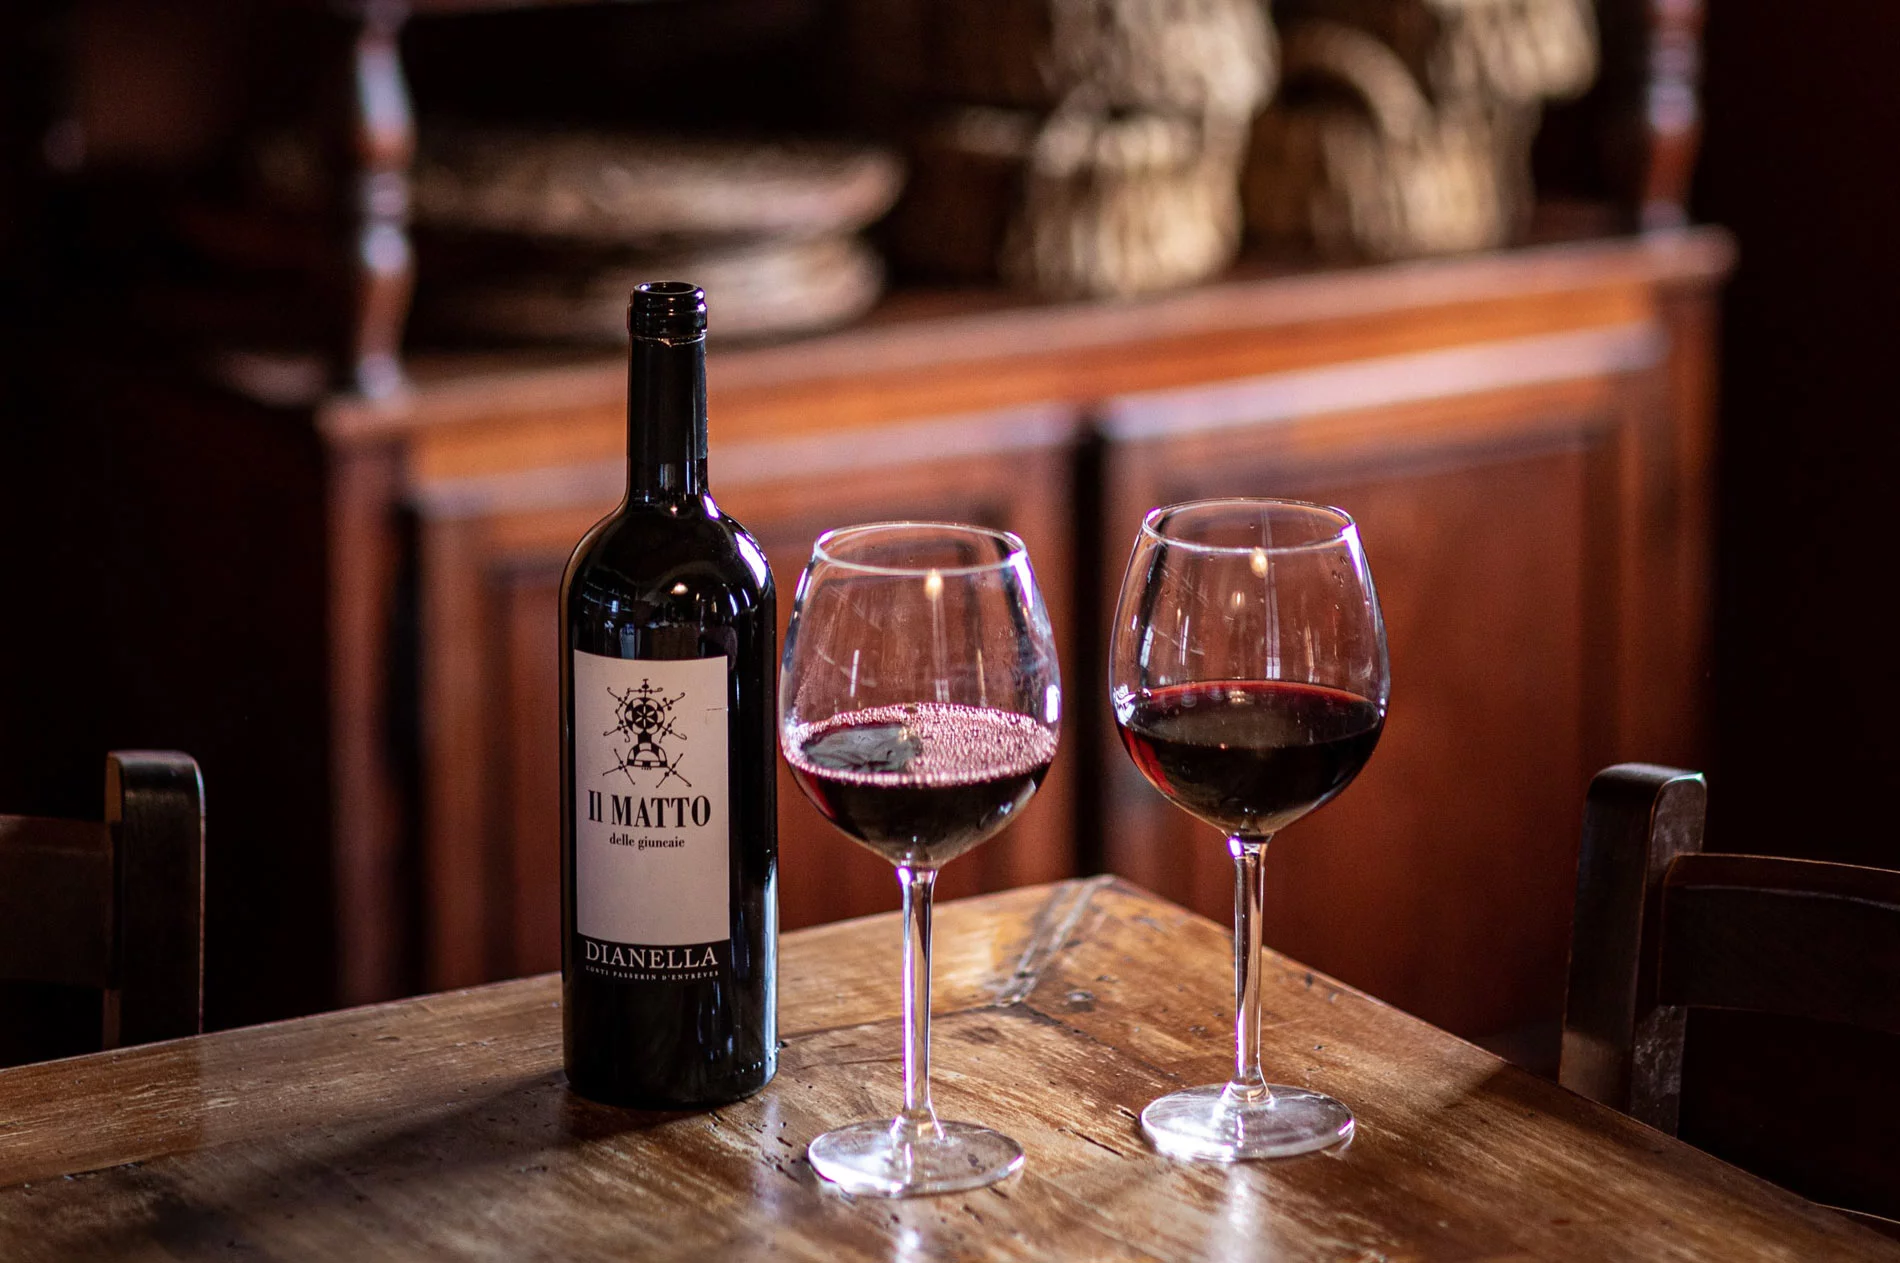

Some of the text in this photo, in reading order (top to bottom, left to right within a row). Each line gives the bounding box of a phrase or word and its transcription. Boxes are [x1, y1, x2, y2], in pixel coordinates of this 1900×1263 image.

[588, 790, 711, 828] Il MATTO
[609, 832, 685, 851] delle giuncaie
[585, 940, 718, 969] DIANELLA
